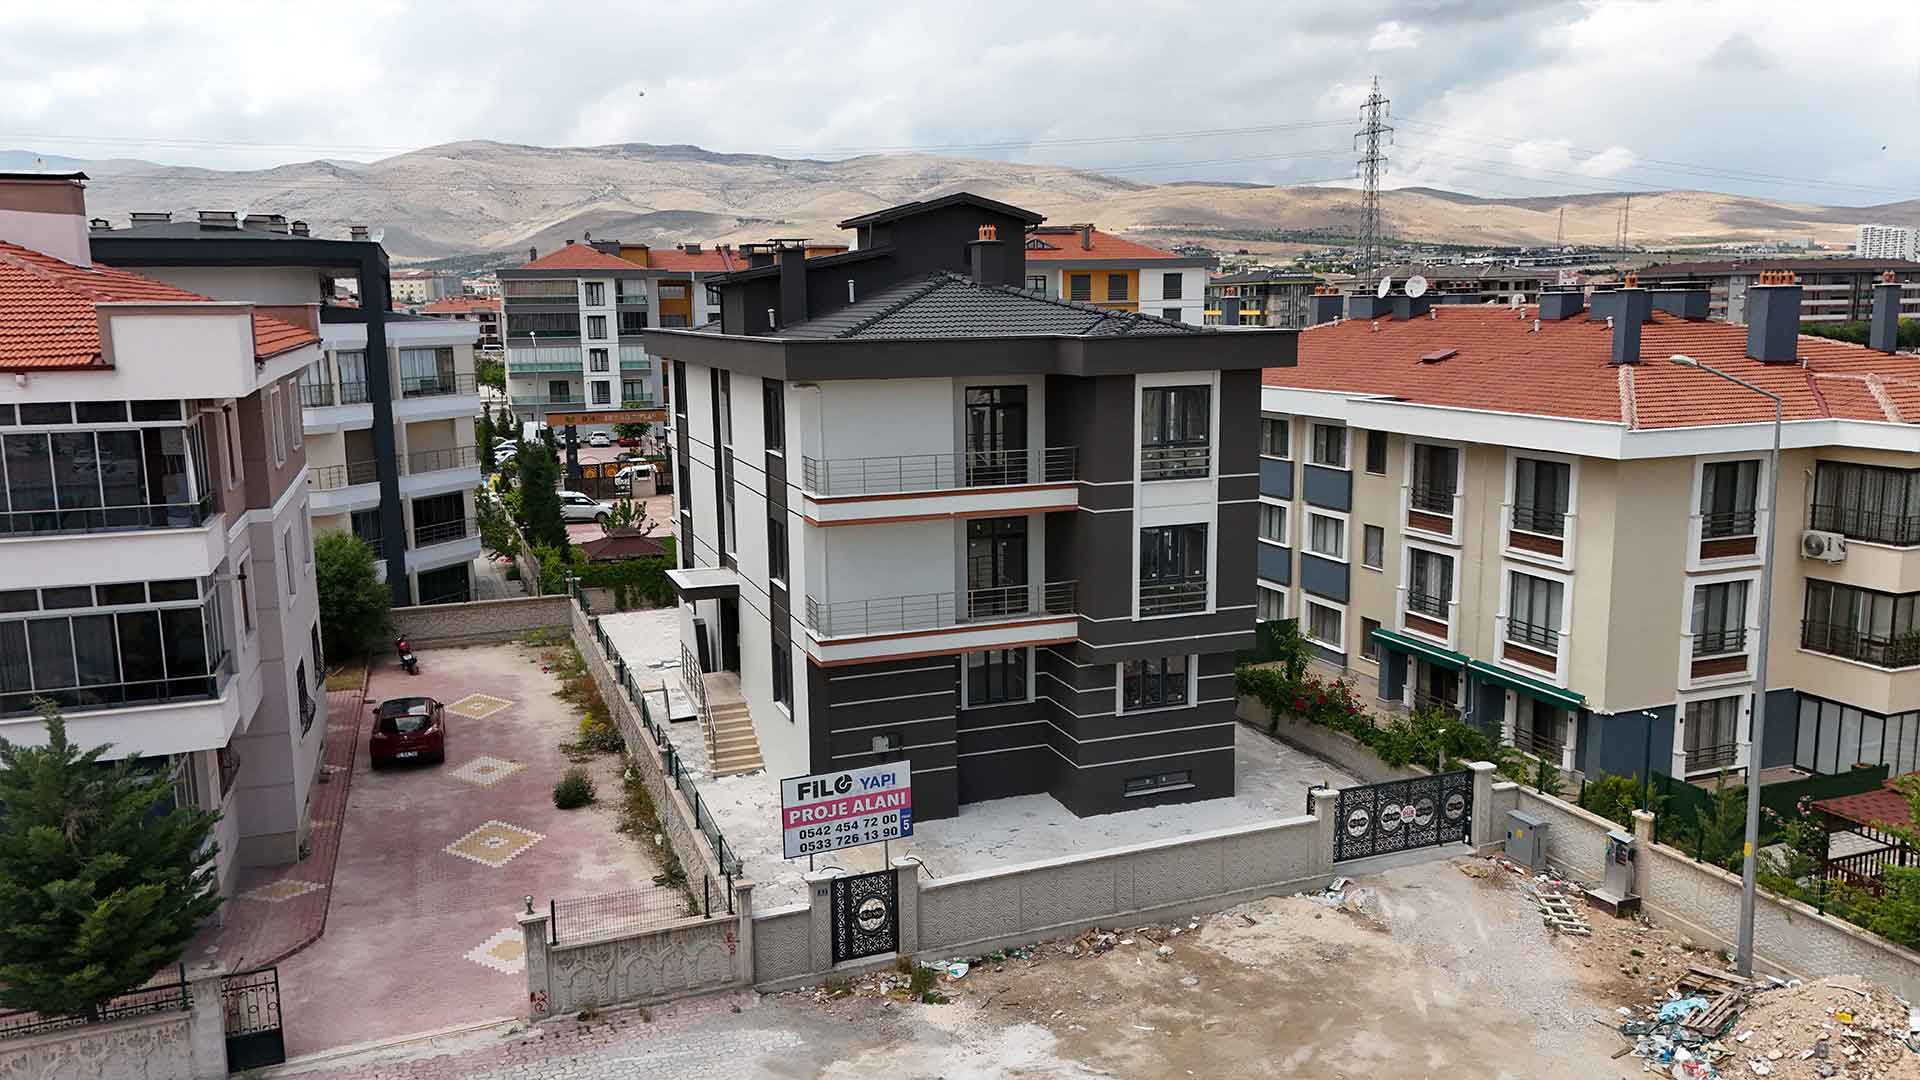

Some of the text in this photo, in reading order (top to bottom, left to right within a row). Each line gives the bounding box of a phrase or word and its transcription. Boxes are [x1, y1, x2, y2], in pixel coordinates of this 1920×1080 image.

[860, 773, 896, 790] YAPI
[789, 791, 906, 825] PROJE ALANI
[800, 814, 897, 840] 0542 454 72 00
[903, 819, 910, 831] 5
[800, 826, 898, 853] 0533 726 13 90
